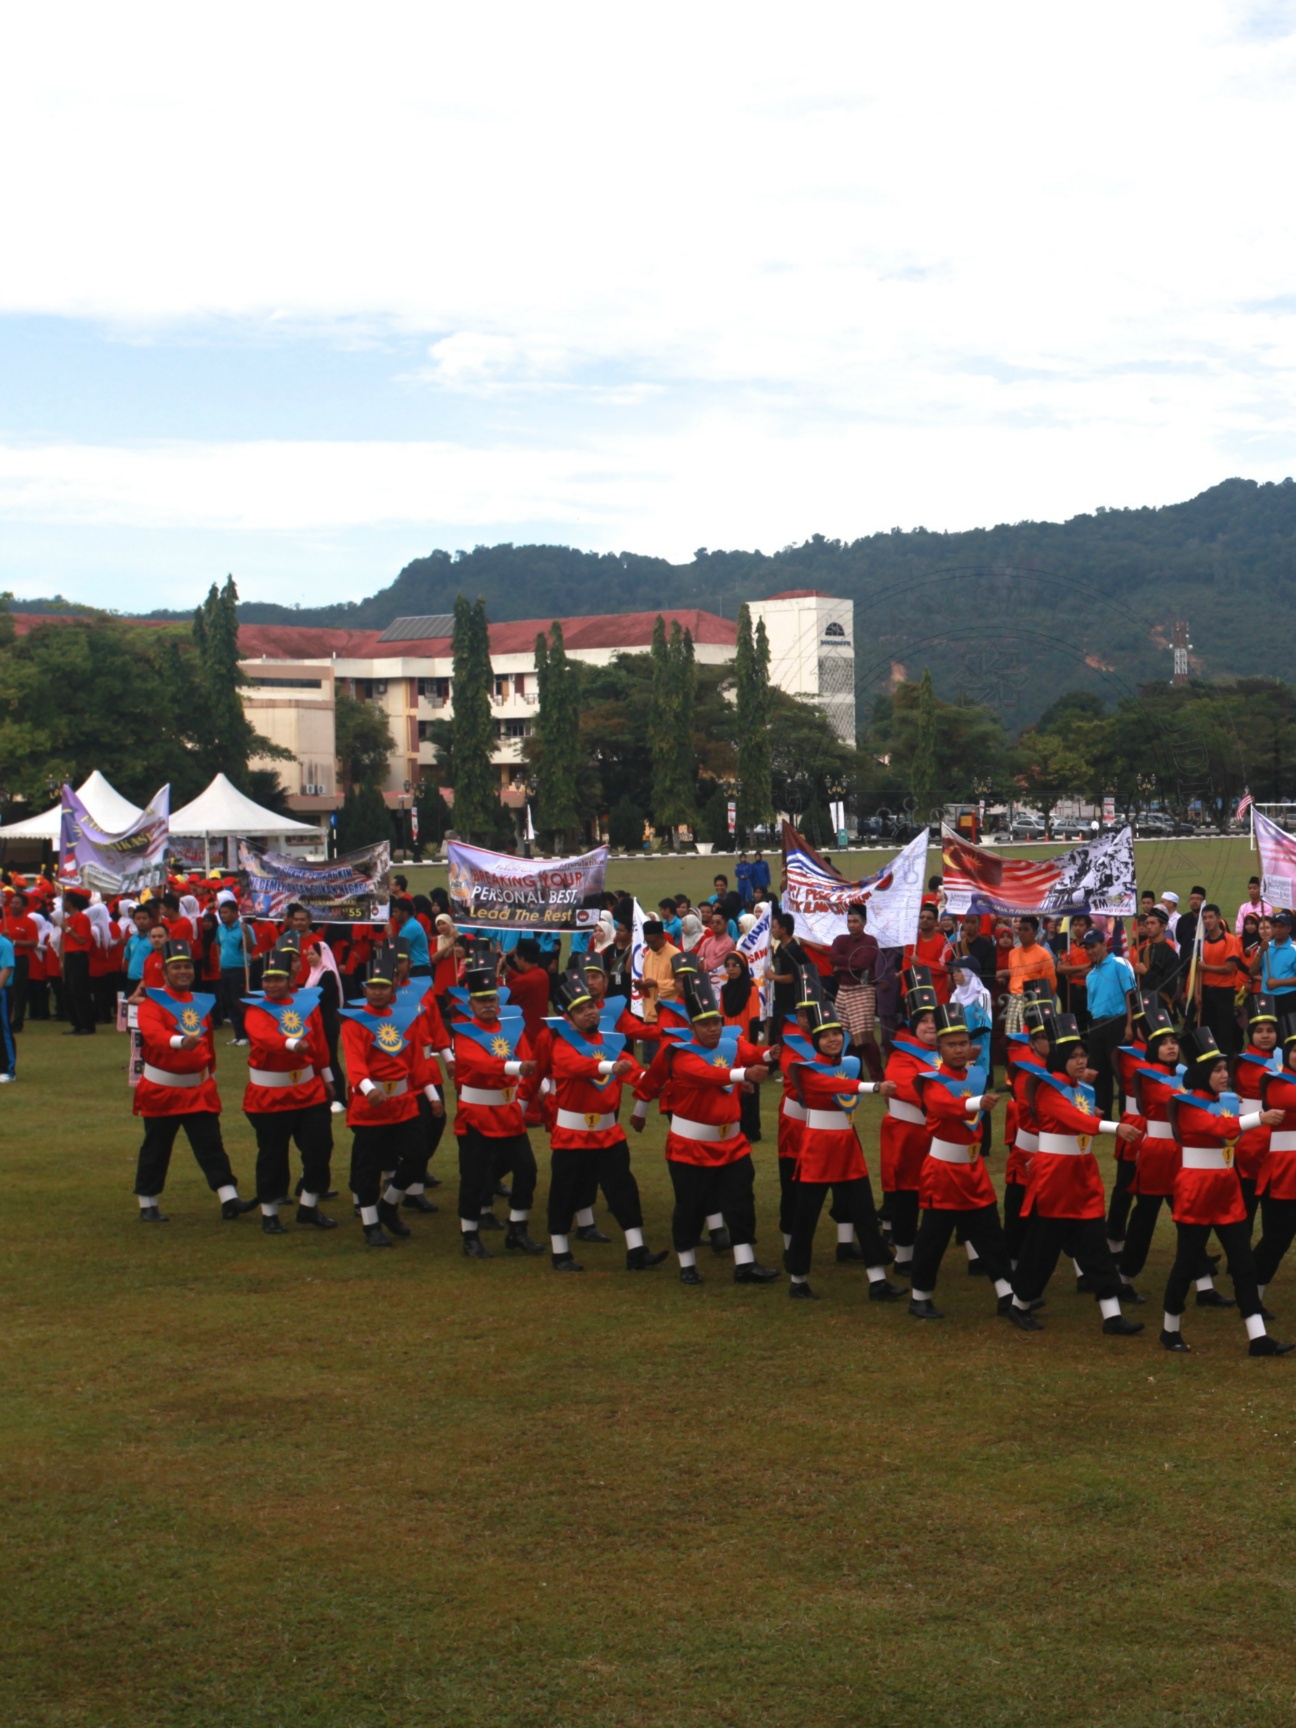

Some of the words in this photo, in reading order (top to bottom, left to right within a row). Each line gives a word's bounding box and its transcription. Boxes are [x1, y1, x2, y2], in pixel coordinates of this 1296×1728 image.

[473, 868, 536, 887] BREAKING
[539, 871, 584, 887] YOUR
[471, 886, 545, 904] PERSONAL
[550, 889, 577, 904] BEST,
[470, 906, 511, 920] Lead
[515, 909, 539, 921] The
[544, 909, 572, 922] Rest
